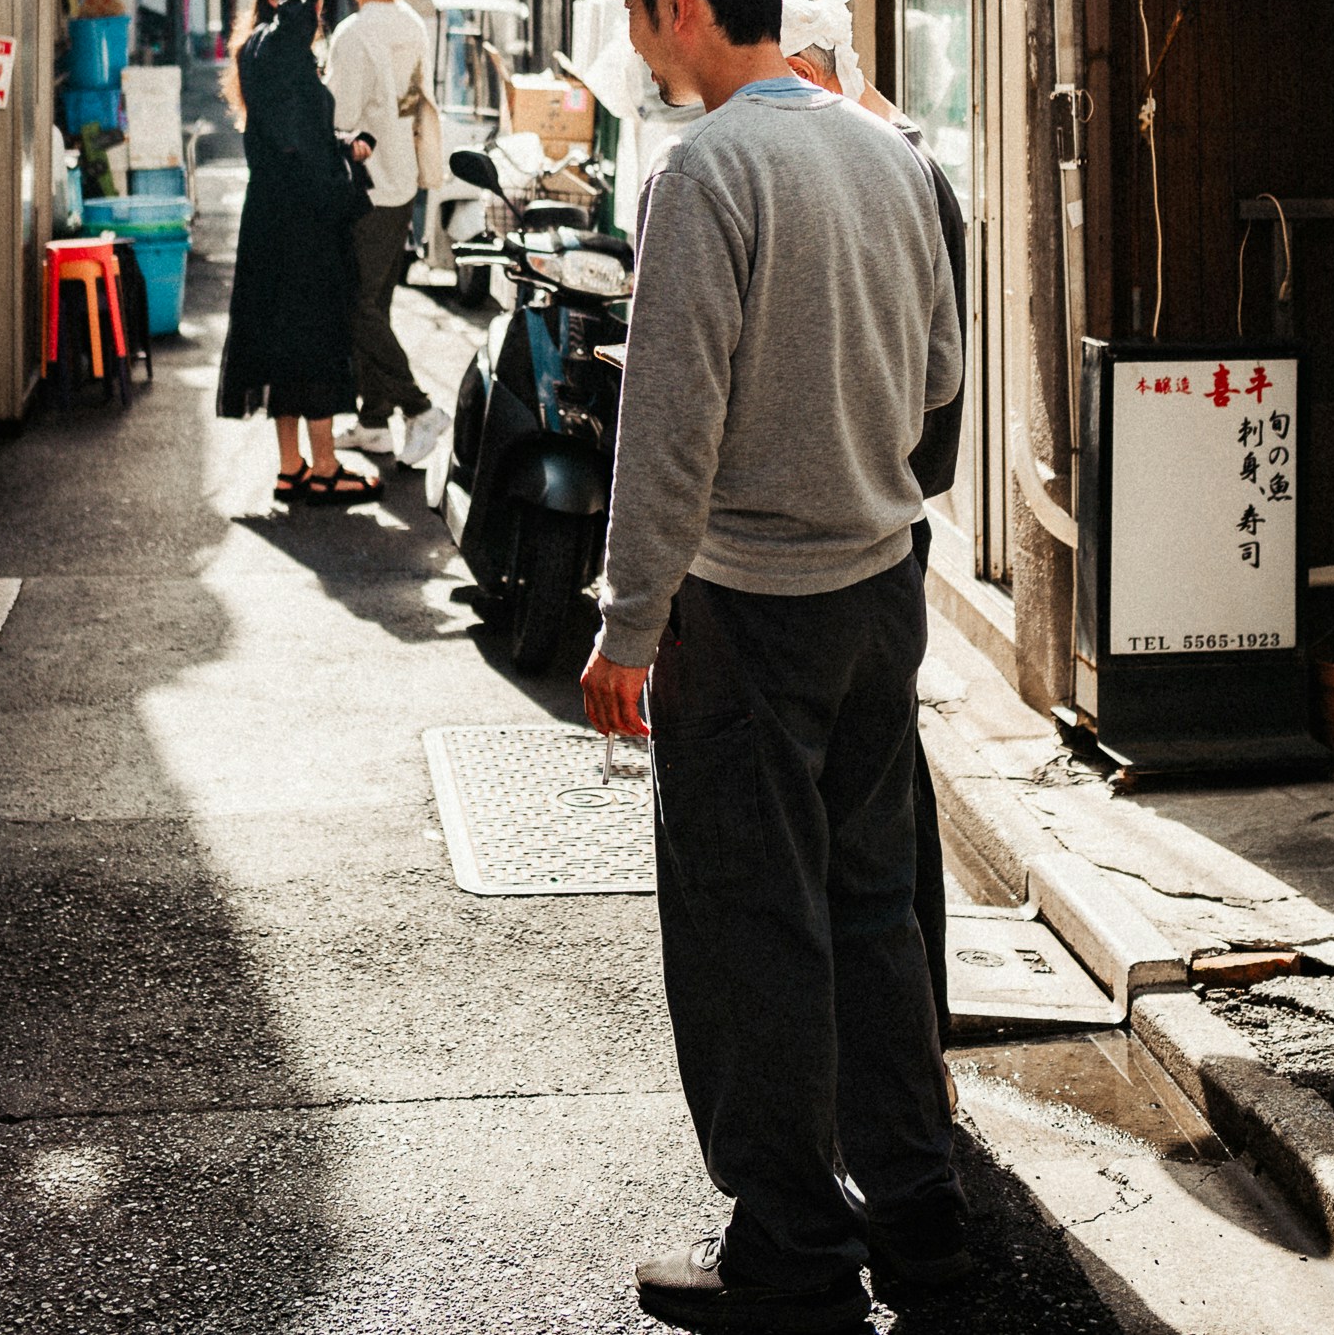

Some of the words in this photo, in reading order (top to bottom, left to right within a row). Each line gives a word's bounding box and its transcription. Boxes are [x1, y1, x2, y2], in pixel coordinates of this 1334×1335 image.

[1135, 376, 1193, 396] 本醸造
[1203, 363, 1274, 408] 喜平
[1267, 409, 1294, 503] 旬の魚
[1128, 635, 1171, 652] TEL
[1183, 632, 1281, 650] 5565-1923
